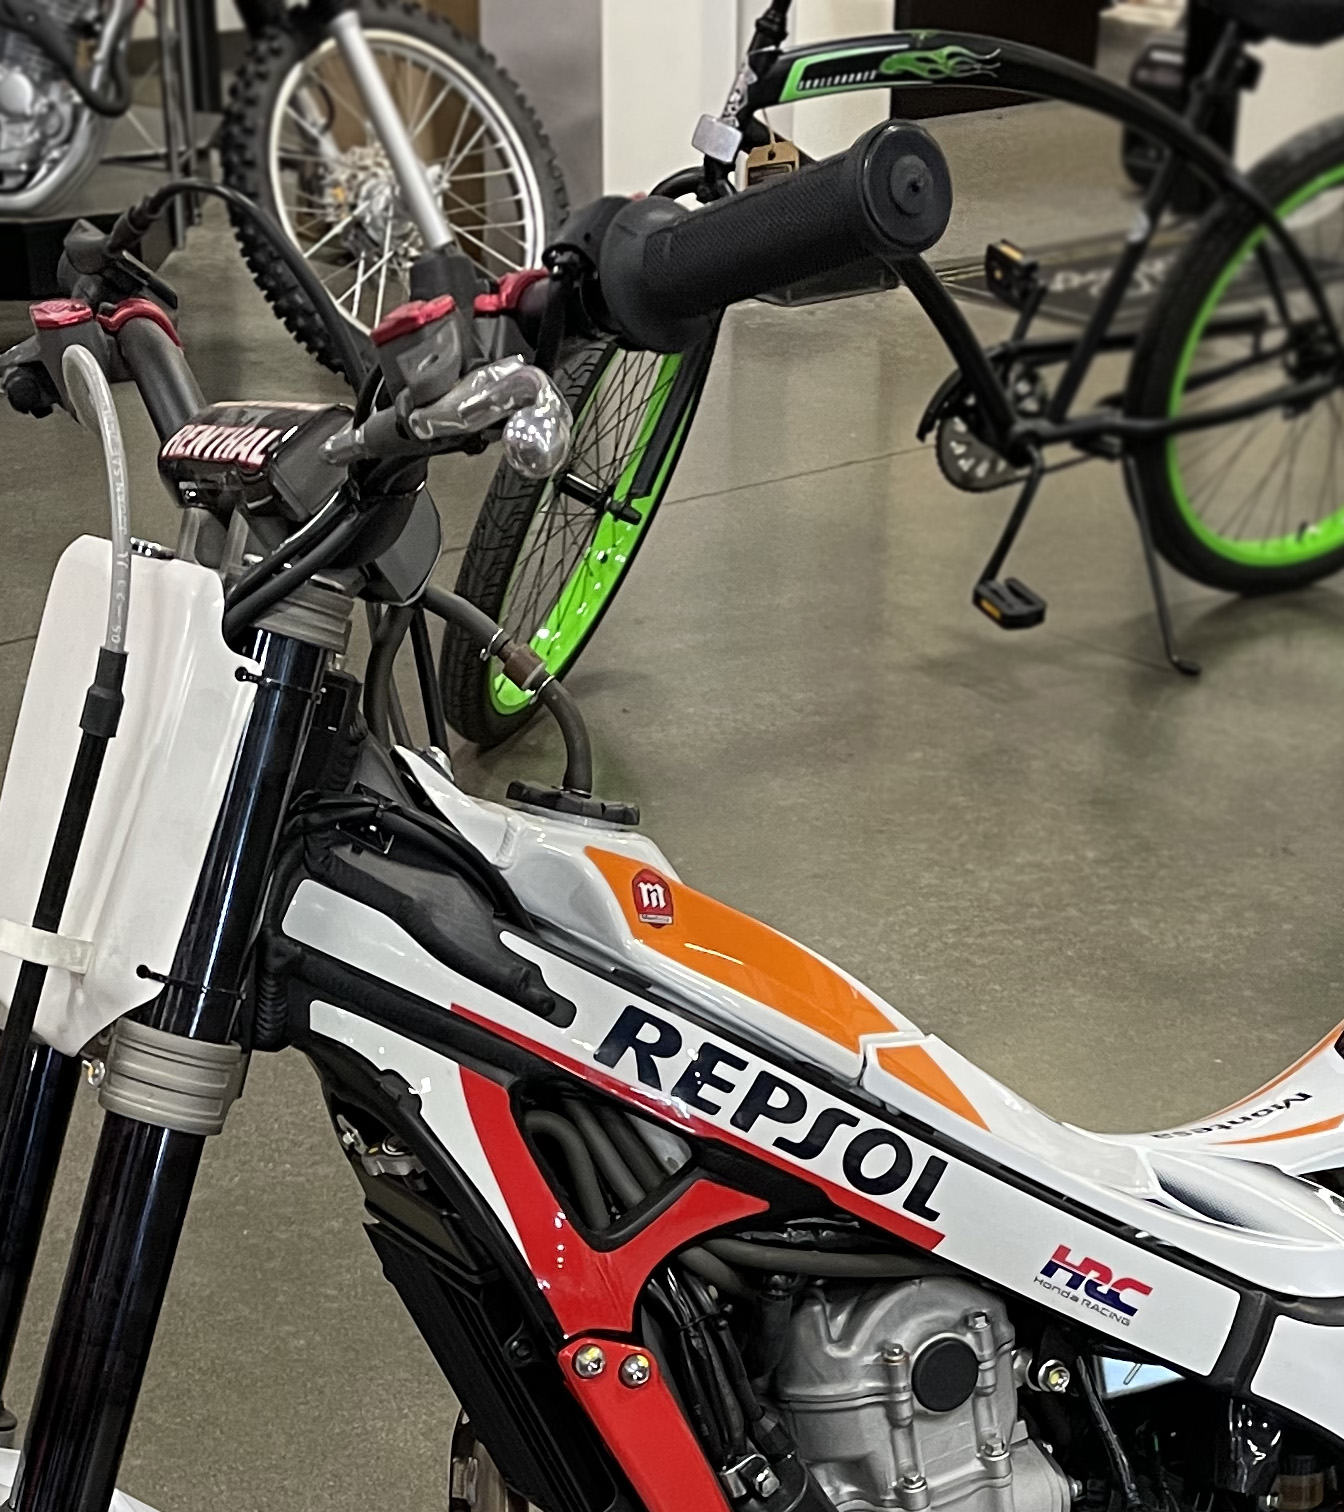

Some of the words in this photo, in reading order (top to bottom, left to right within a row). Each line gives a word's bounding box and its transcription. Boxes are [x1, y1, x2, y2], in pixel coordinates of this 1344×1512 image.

[160, 424, 284, 465] RENTHAL
[593, 1004, 951, 1223] REPSOL
[1150, 1091, 1313, 1140] Montesa
[1033, 1275, 1079, 1303] Honda
[1080, 1298, 1131, 1327] RACING
[1040, 1244, 1153, 1317] HRC
